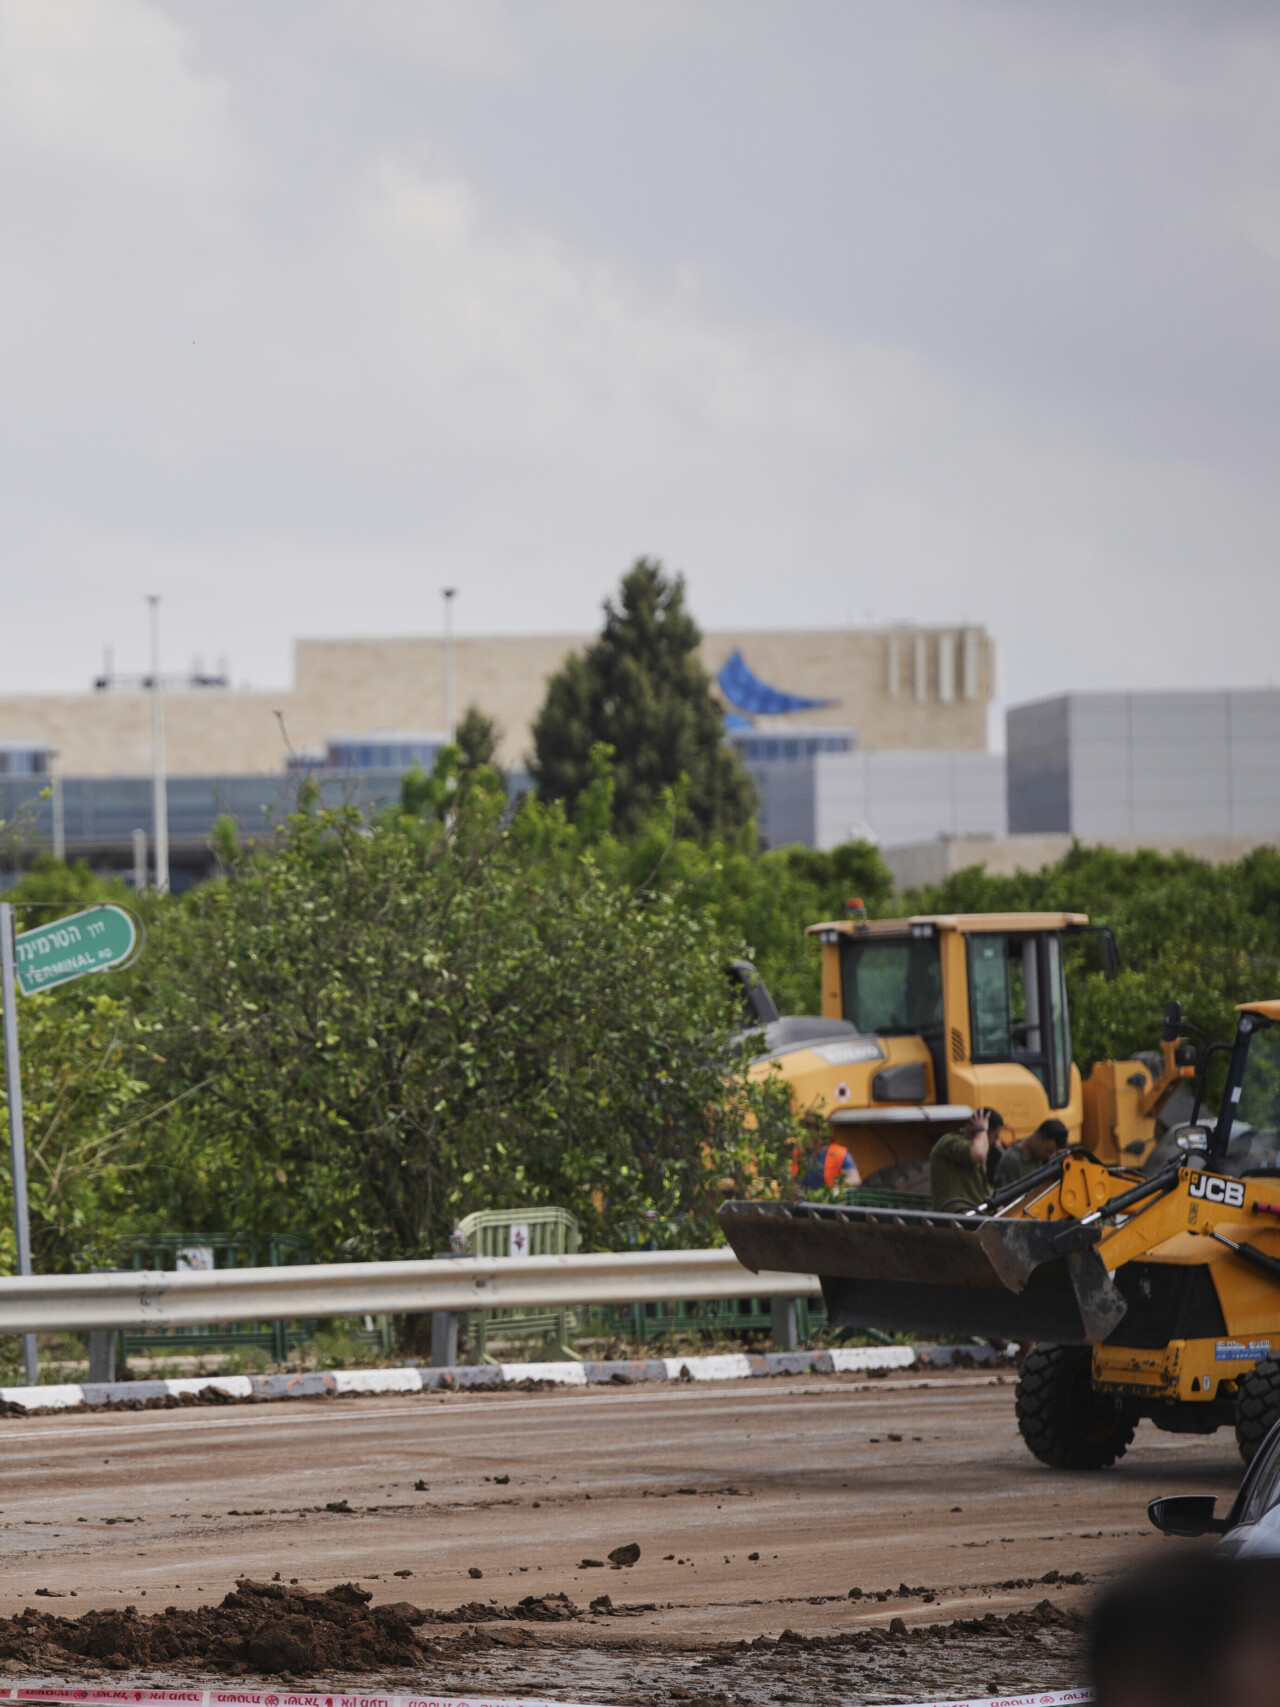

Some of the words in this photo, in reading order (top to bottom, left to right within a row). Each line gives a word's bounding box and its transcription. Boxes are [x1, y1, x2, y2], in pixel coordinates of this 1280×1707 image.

[25, 952, 96, 984] TERMINAL
[98, 948, 113, 959] RD
[1190, 1175, 1244, 1207] JCB
